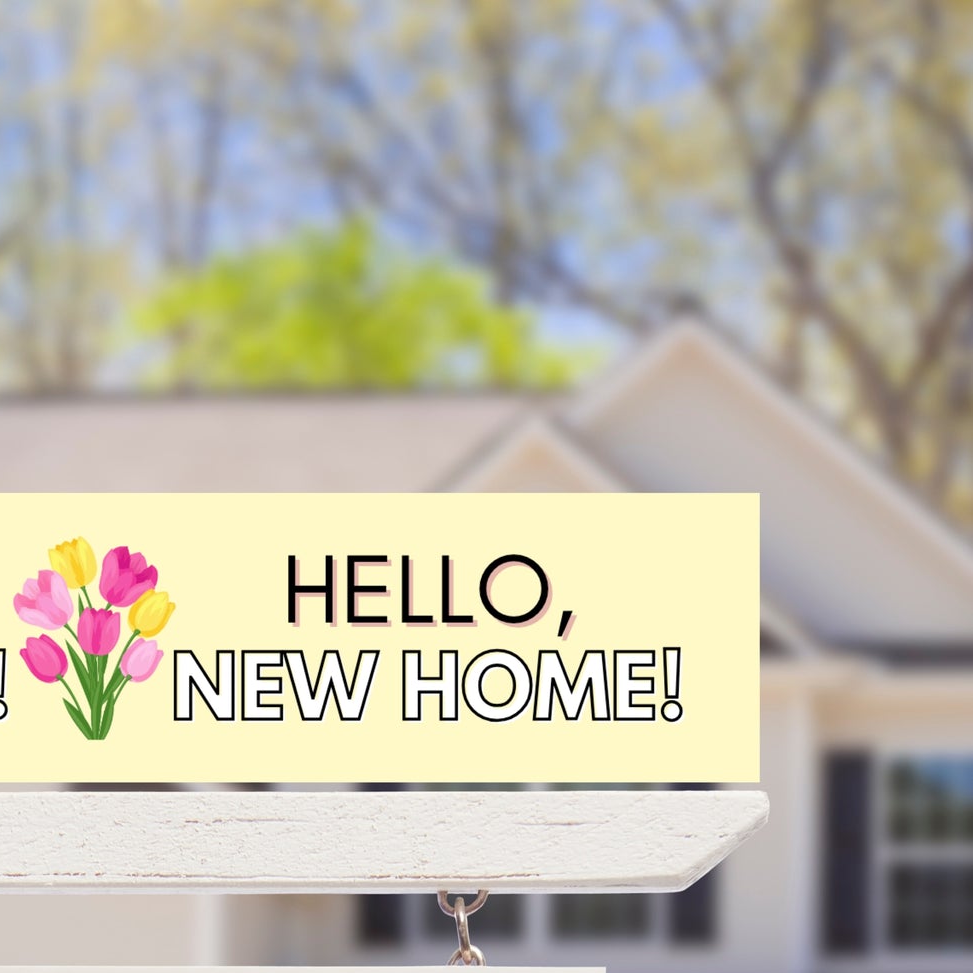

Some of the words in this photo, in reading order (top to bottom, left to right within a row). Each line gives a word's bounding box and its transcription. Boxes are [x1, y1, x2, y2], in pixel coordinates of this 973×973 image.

[287, 554, 575, 638] HELLO,
[173, 648, 381, 722] NEW
[402, 646, 684, 723] HOME!
